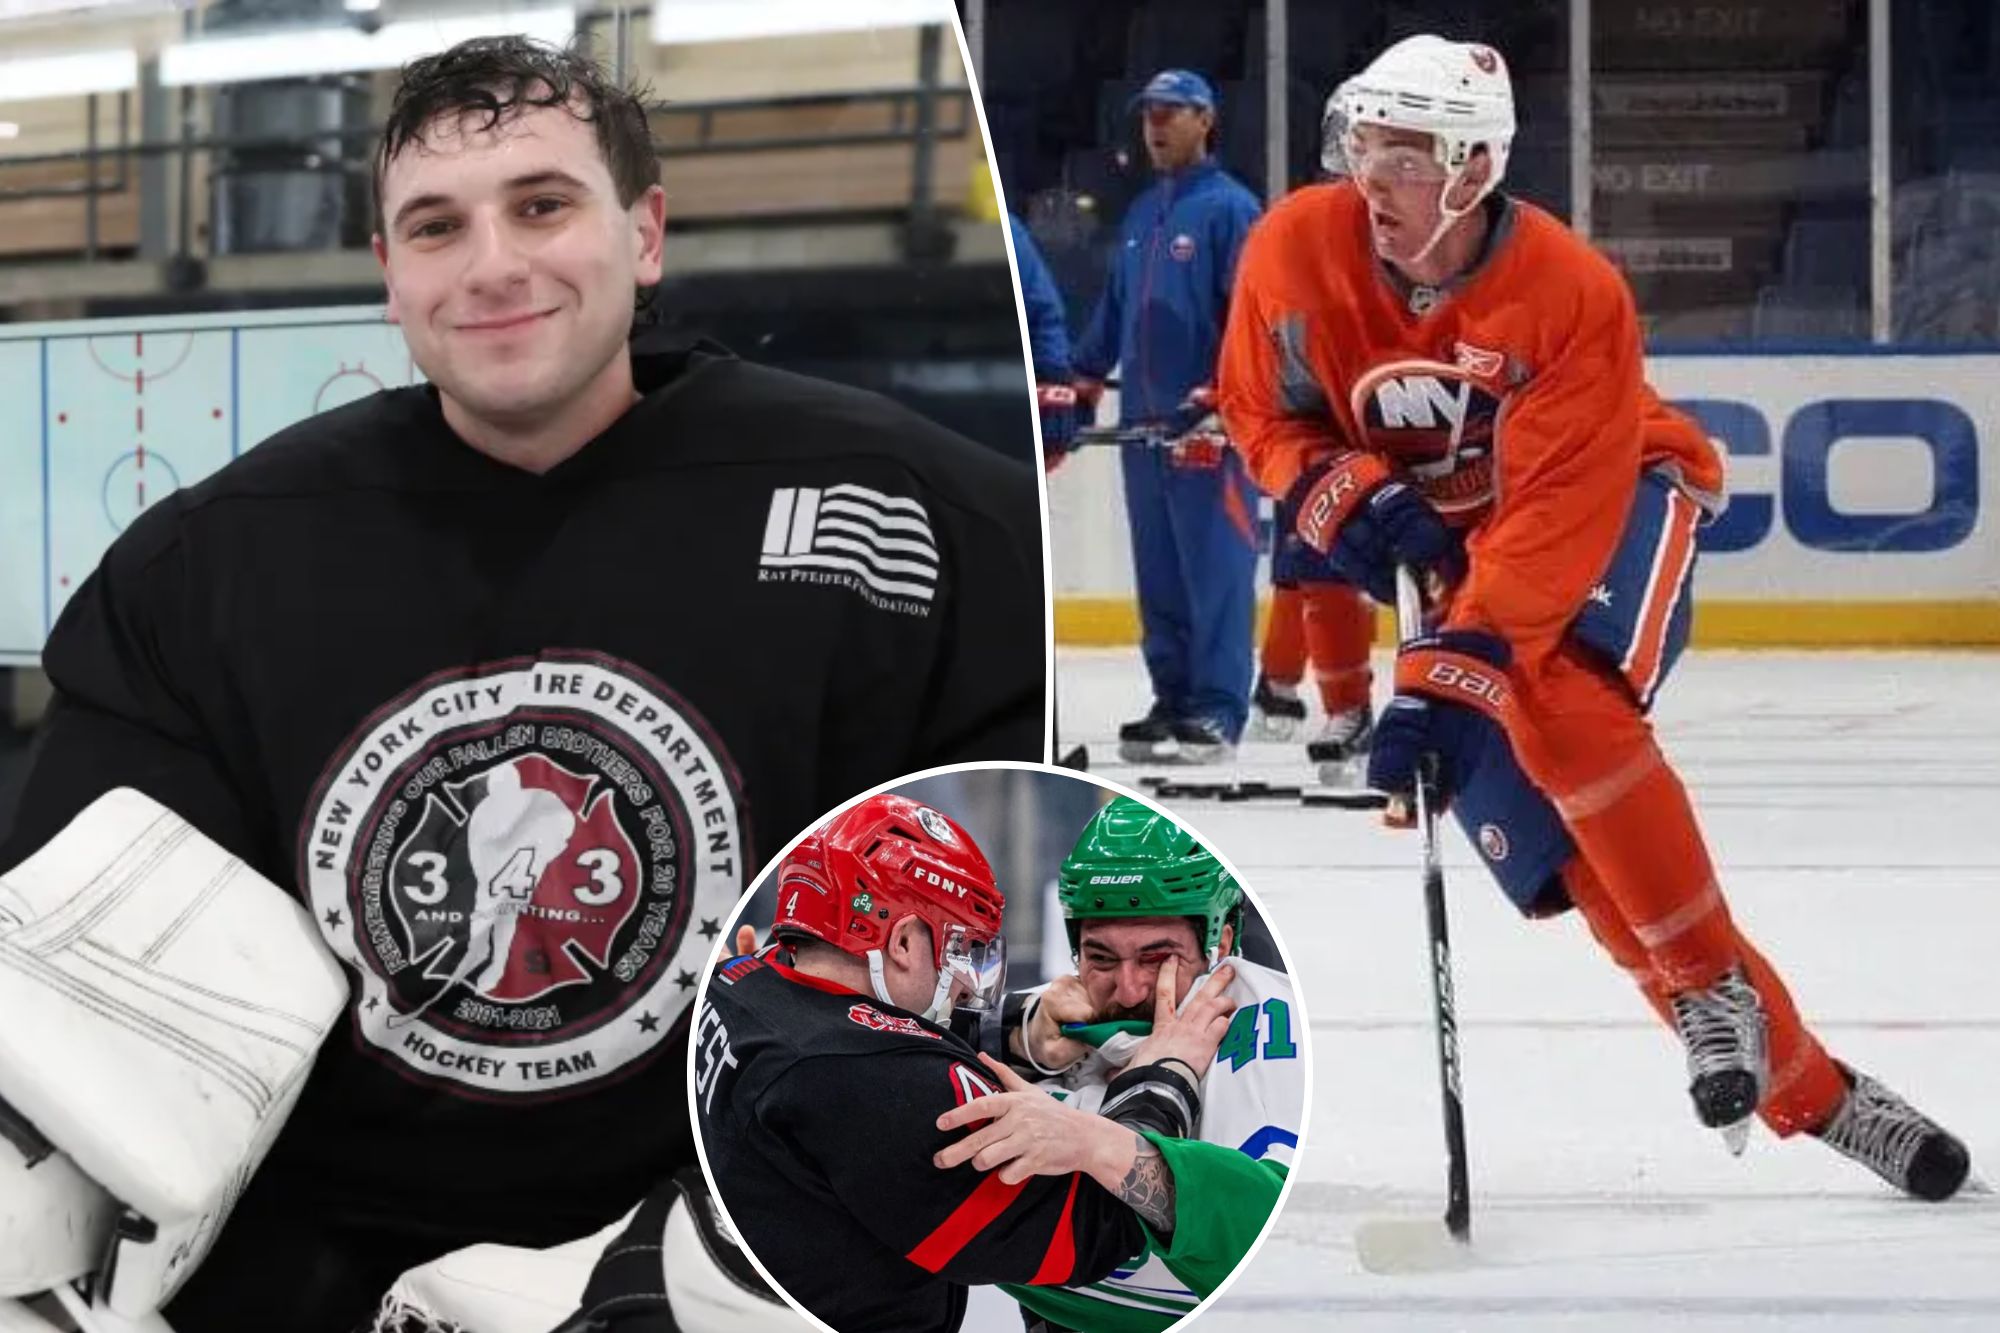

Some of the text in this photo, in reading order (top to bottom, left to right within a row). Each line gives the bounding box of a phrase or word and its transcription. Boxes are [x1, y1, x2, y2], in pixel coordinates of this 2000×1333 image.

[1592, 164, 1712, 193] NO EXIT
[758, 569, 931, 618] RAY PFEIFER FUNDATION
[315, 673, 733, 878] NEW YORK CITY IRE DEPARTMENT
[403, 757, 452, 799] OUR
[541, 726, 653, 806] BROTHERS
[640, 804, 676, 862] FOR
[403, 847, 623, 906] 3 4 3
[651, 864, 676, 895] 20
[914, 866, 969, 899] FDNY
[1089, 874, 1144, 885] BAUER
[415, 910, 463, 922] AND
[786, 891, 799, 918] 4
[613, 901, 672, 982] YEARS
[453, 998, 562, 1031] 2001-2021
[1216, 997, 1297, 1074] 41
[403, 1031, 597, 1080] HOCKEY TEAM
[697, 998, 739, 1115] EST
